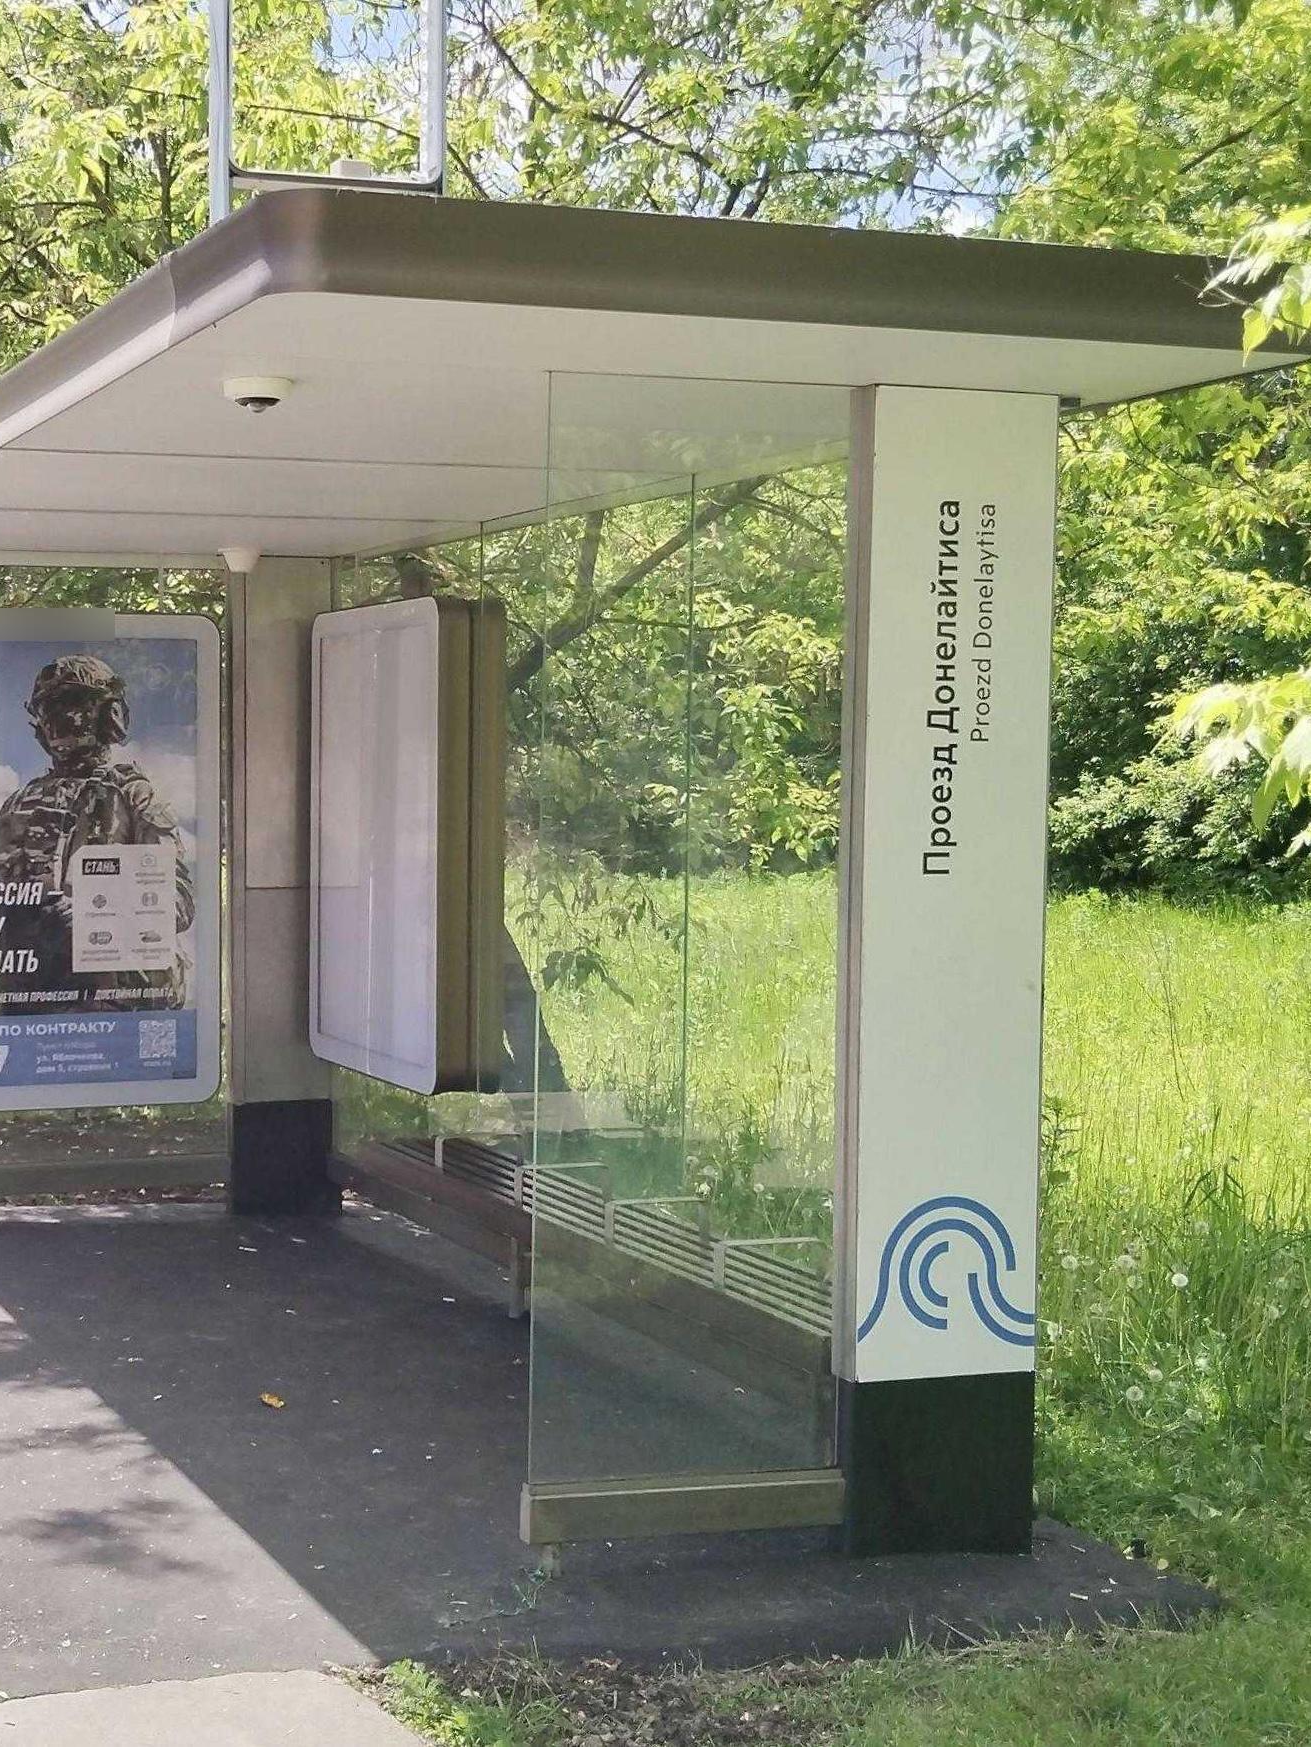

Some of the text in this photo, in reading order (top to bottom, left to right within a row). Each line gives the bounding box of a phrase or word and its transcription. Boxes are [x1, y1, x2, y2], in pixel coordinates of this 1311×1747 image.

[922, 500, 961, 875] Проезд Донелайтиса
[970, 503, 1000, 742] Proezd Donelaytisa
[25, 1021, 116, 1036] КОНТРАКТУ
